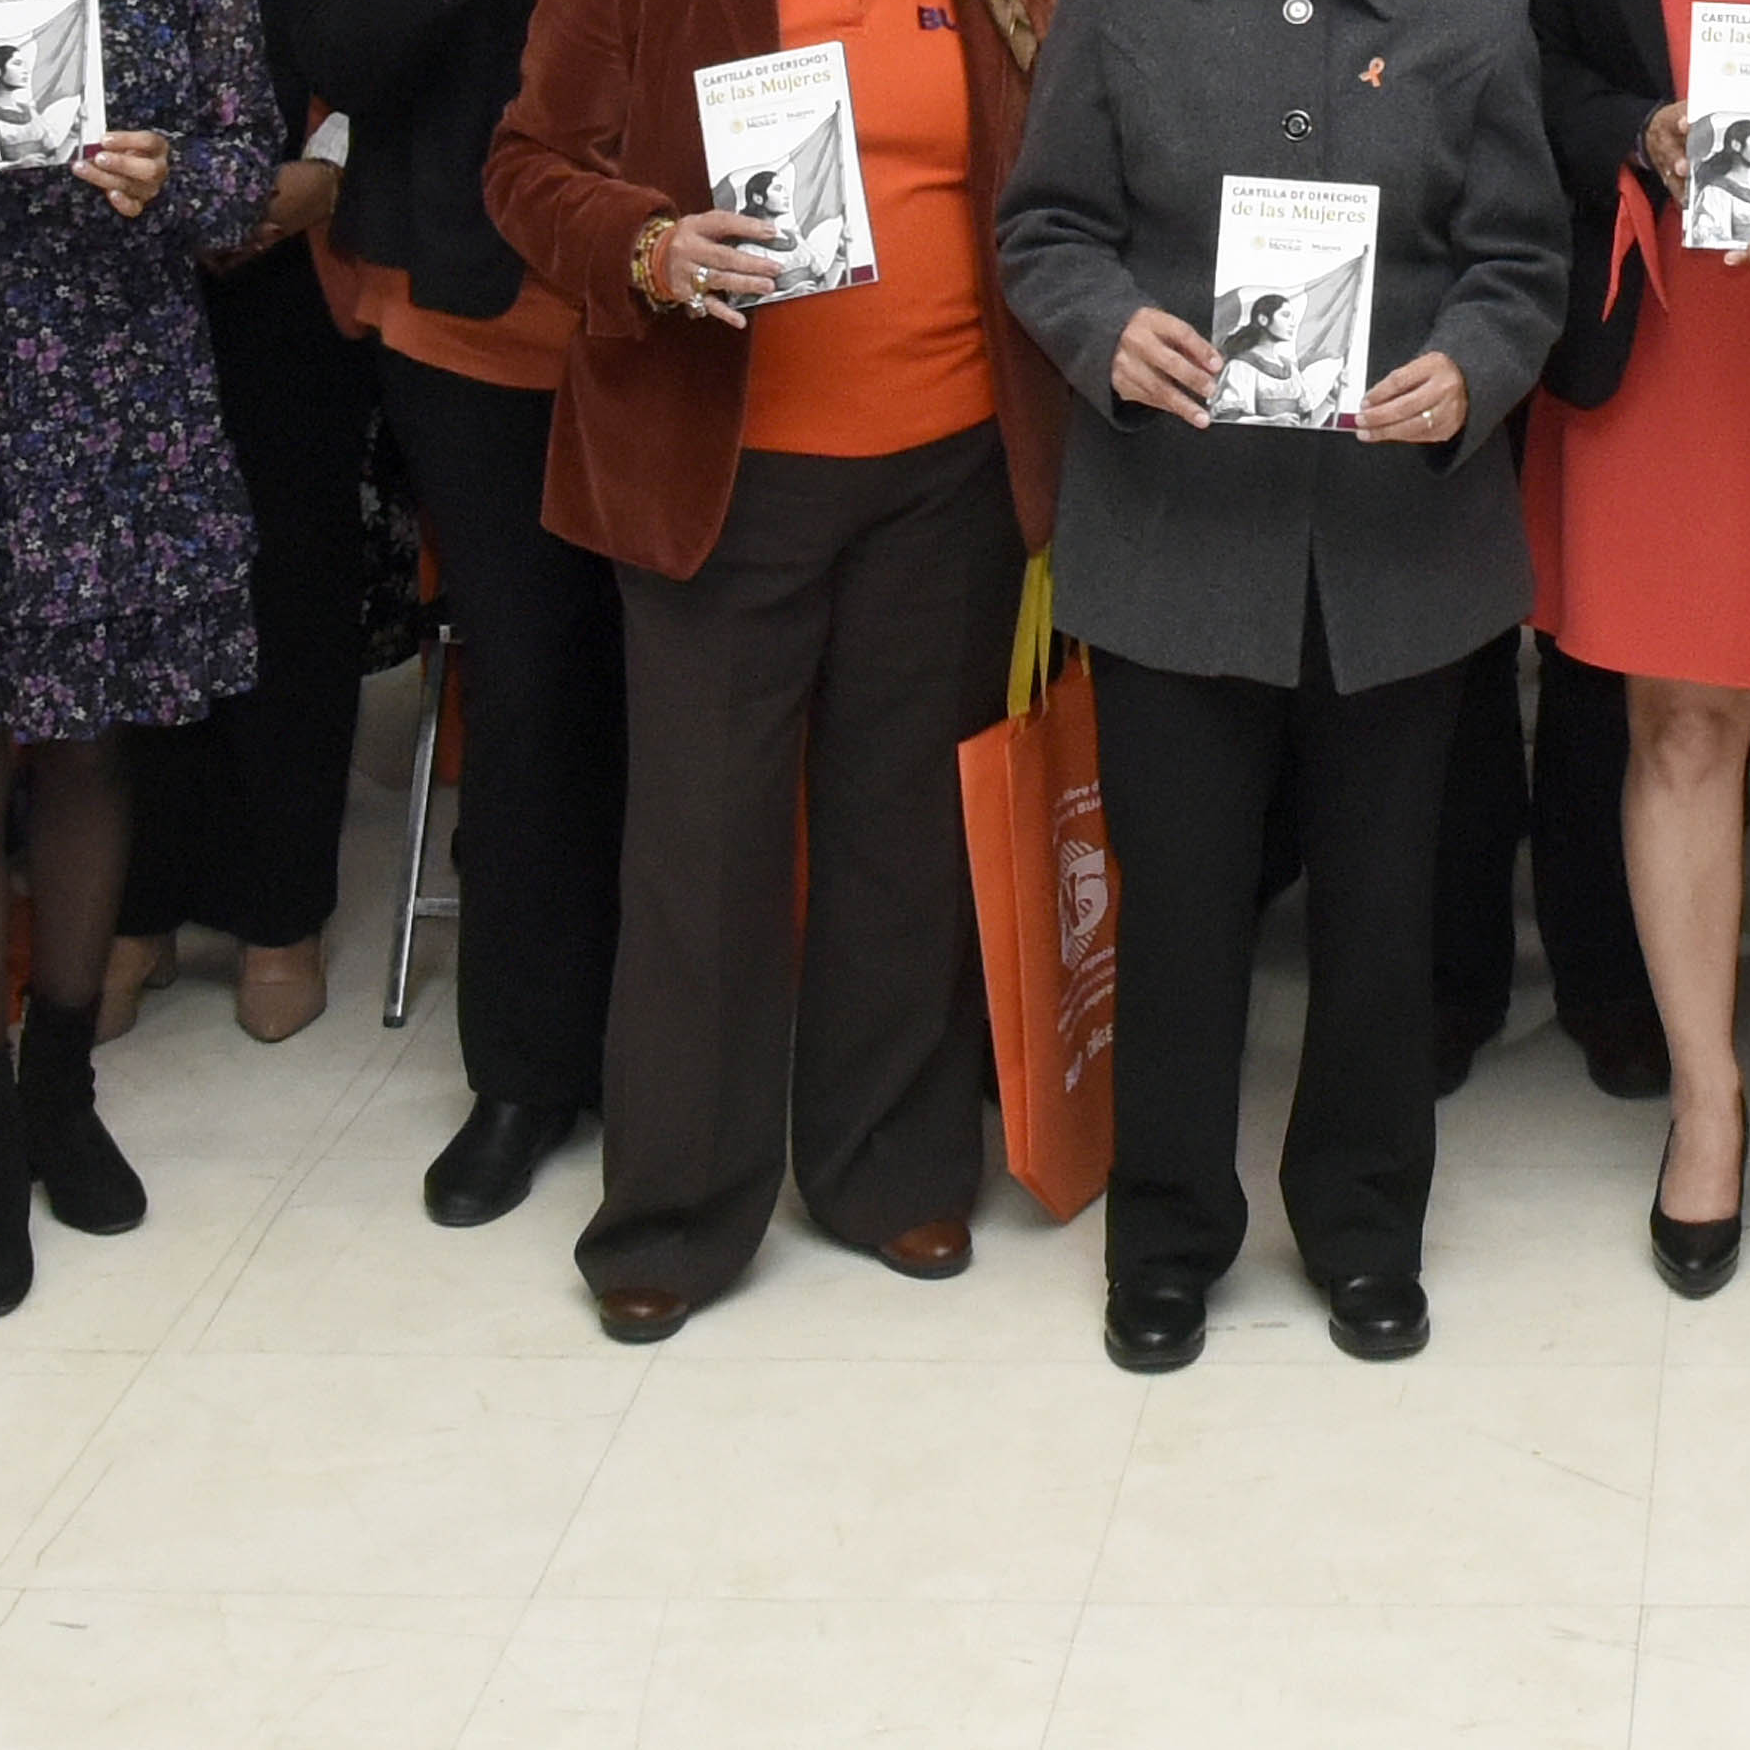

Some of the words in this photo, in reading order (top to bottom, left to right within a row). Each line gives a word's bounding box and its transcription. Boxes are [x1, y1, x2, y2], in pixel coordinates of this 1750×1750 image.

[1700, 26, 1724, 43] de
[701, 68, 753, 89] CARTILLA
[755, 65, 769, 78] DE
[771, 52, 829, 74] DERECHOS
[705, 89, 726, 106] de
[730, 85, 755, 101] las
[759, 69, 830, 95] Mujeres
[1231, 187, 1287, 200] CARTILLA
[1290, 190, 1304, 201] DE
[1307, 192, 1368, 205] DERECHOS
[1231, 200, 1254, 217] de
[1260, 201, 1285, 218] las
[1291, 204, 1367, 225] Mujeres
